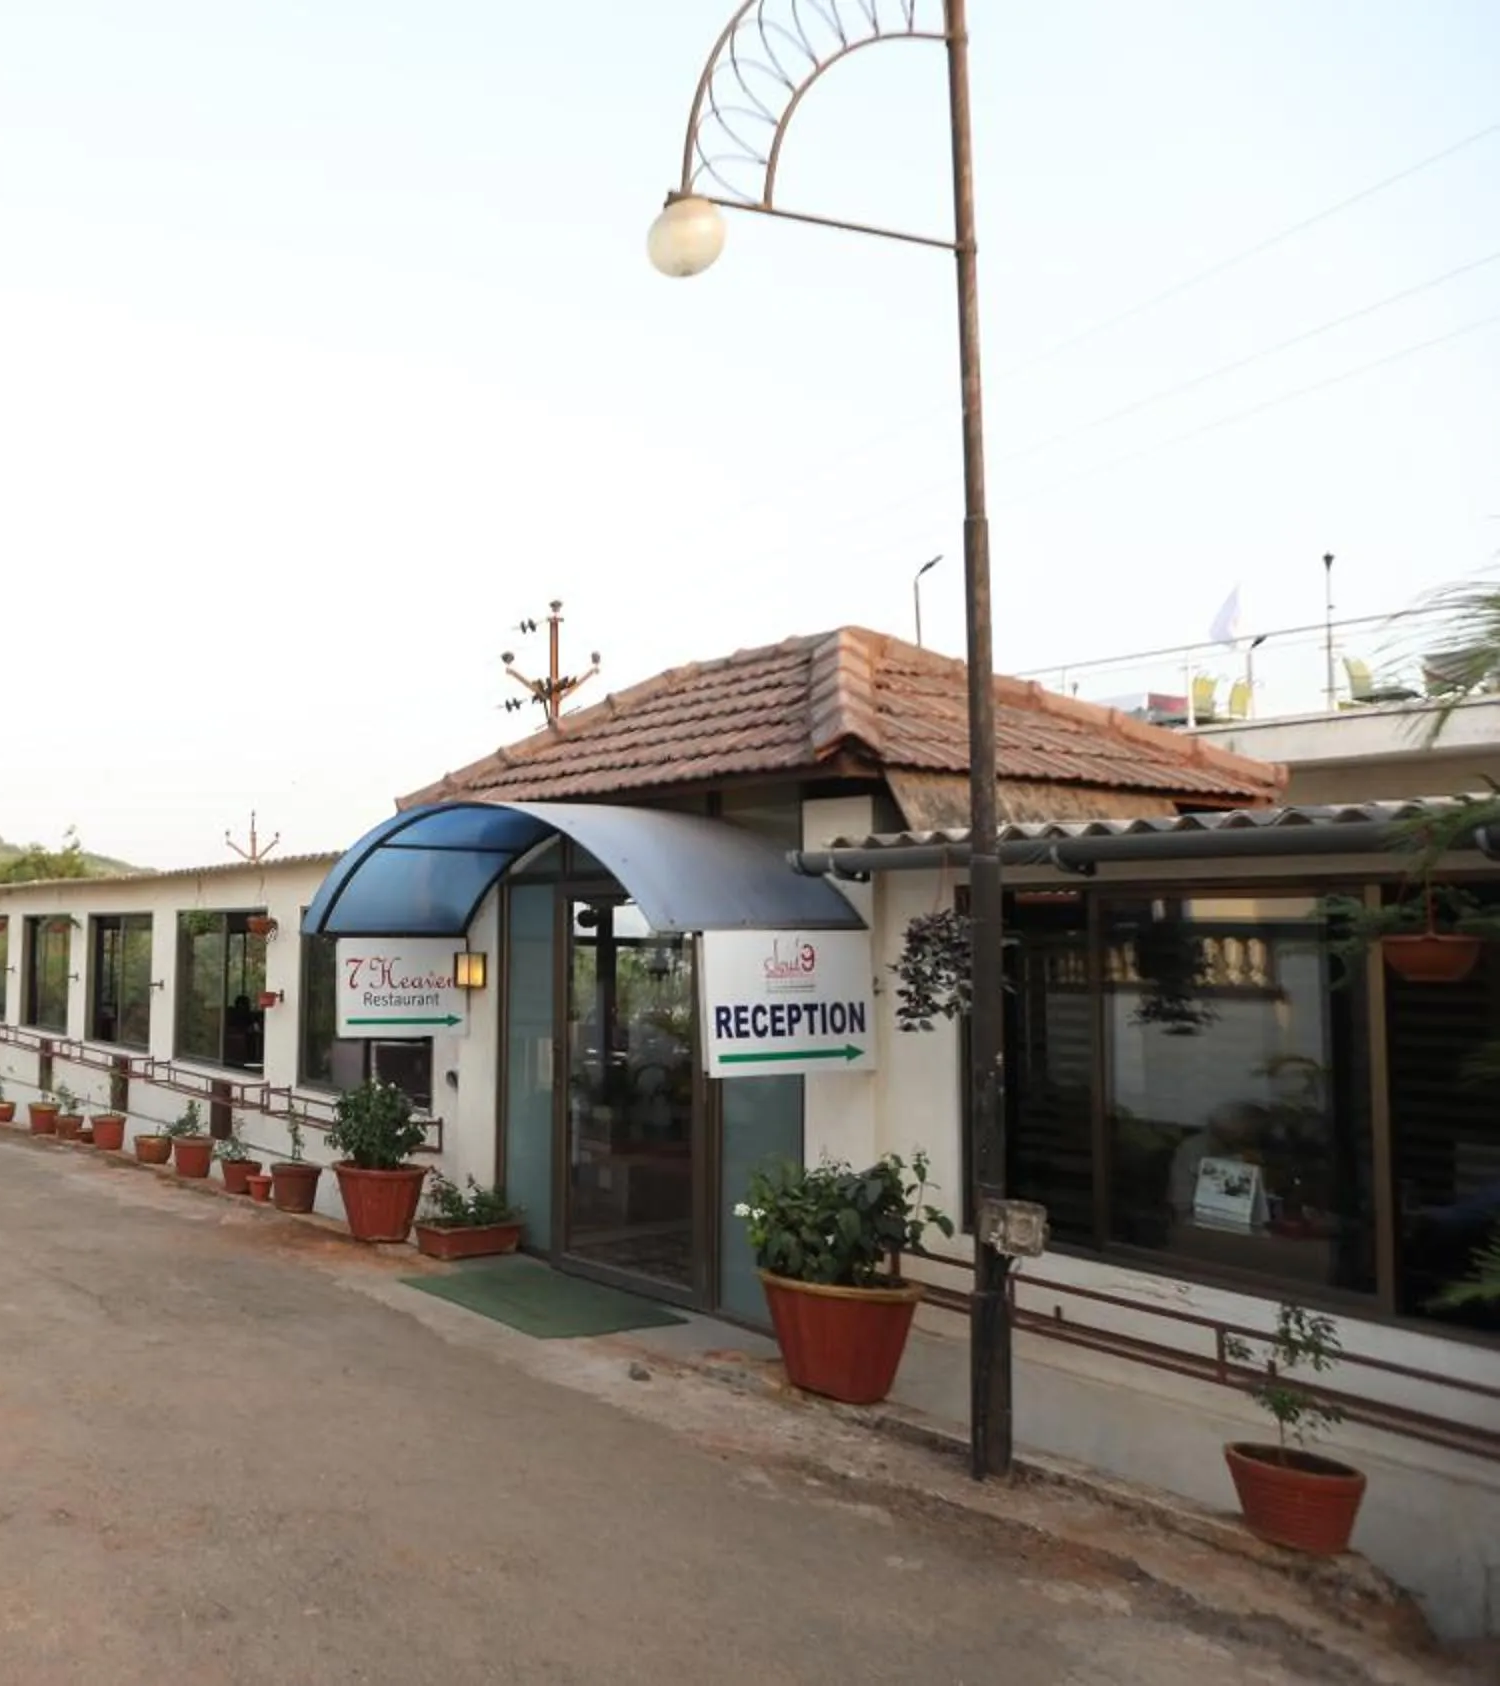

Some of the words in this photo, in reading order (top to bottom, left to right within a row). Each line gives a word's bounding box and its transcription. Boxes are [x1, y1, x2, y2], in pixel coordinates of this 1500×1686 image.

[801, 943, 815, 972] 9
[346, 957, 364, 989] 7
[363, 991, 439, 1007] Restaurant
[715, 1002, 866, 1039] RECEPTION
